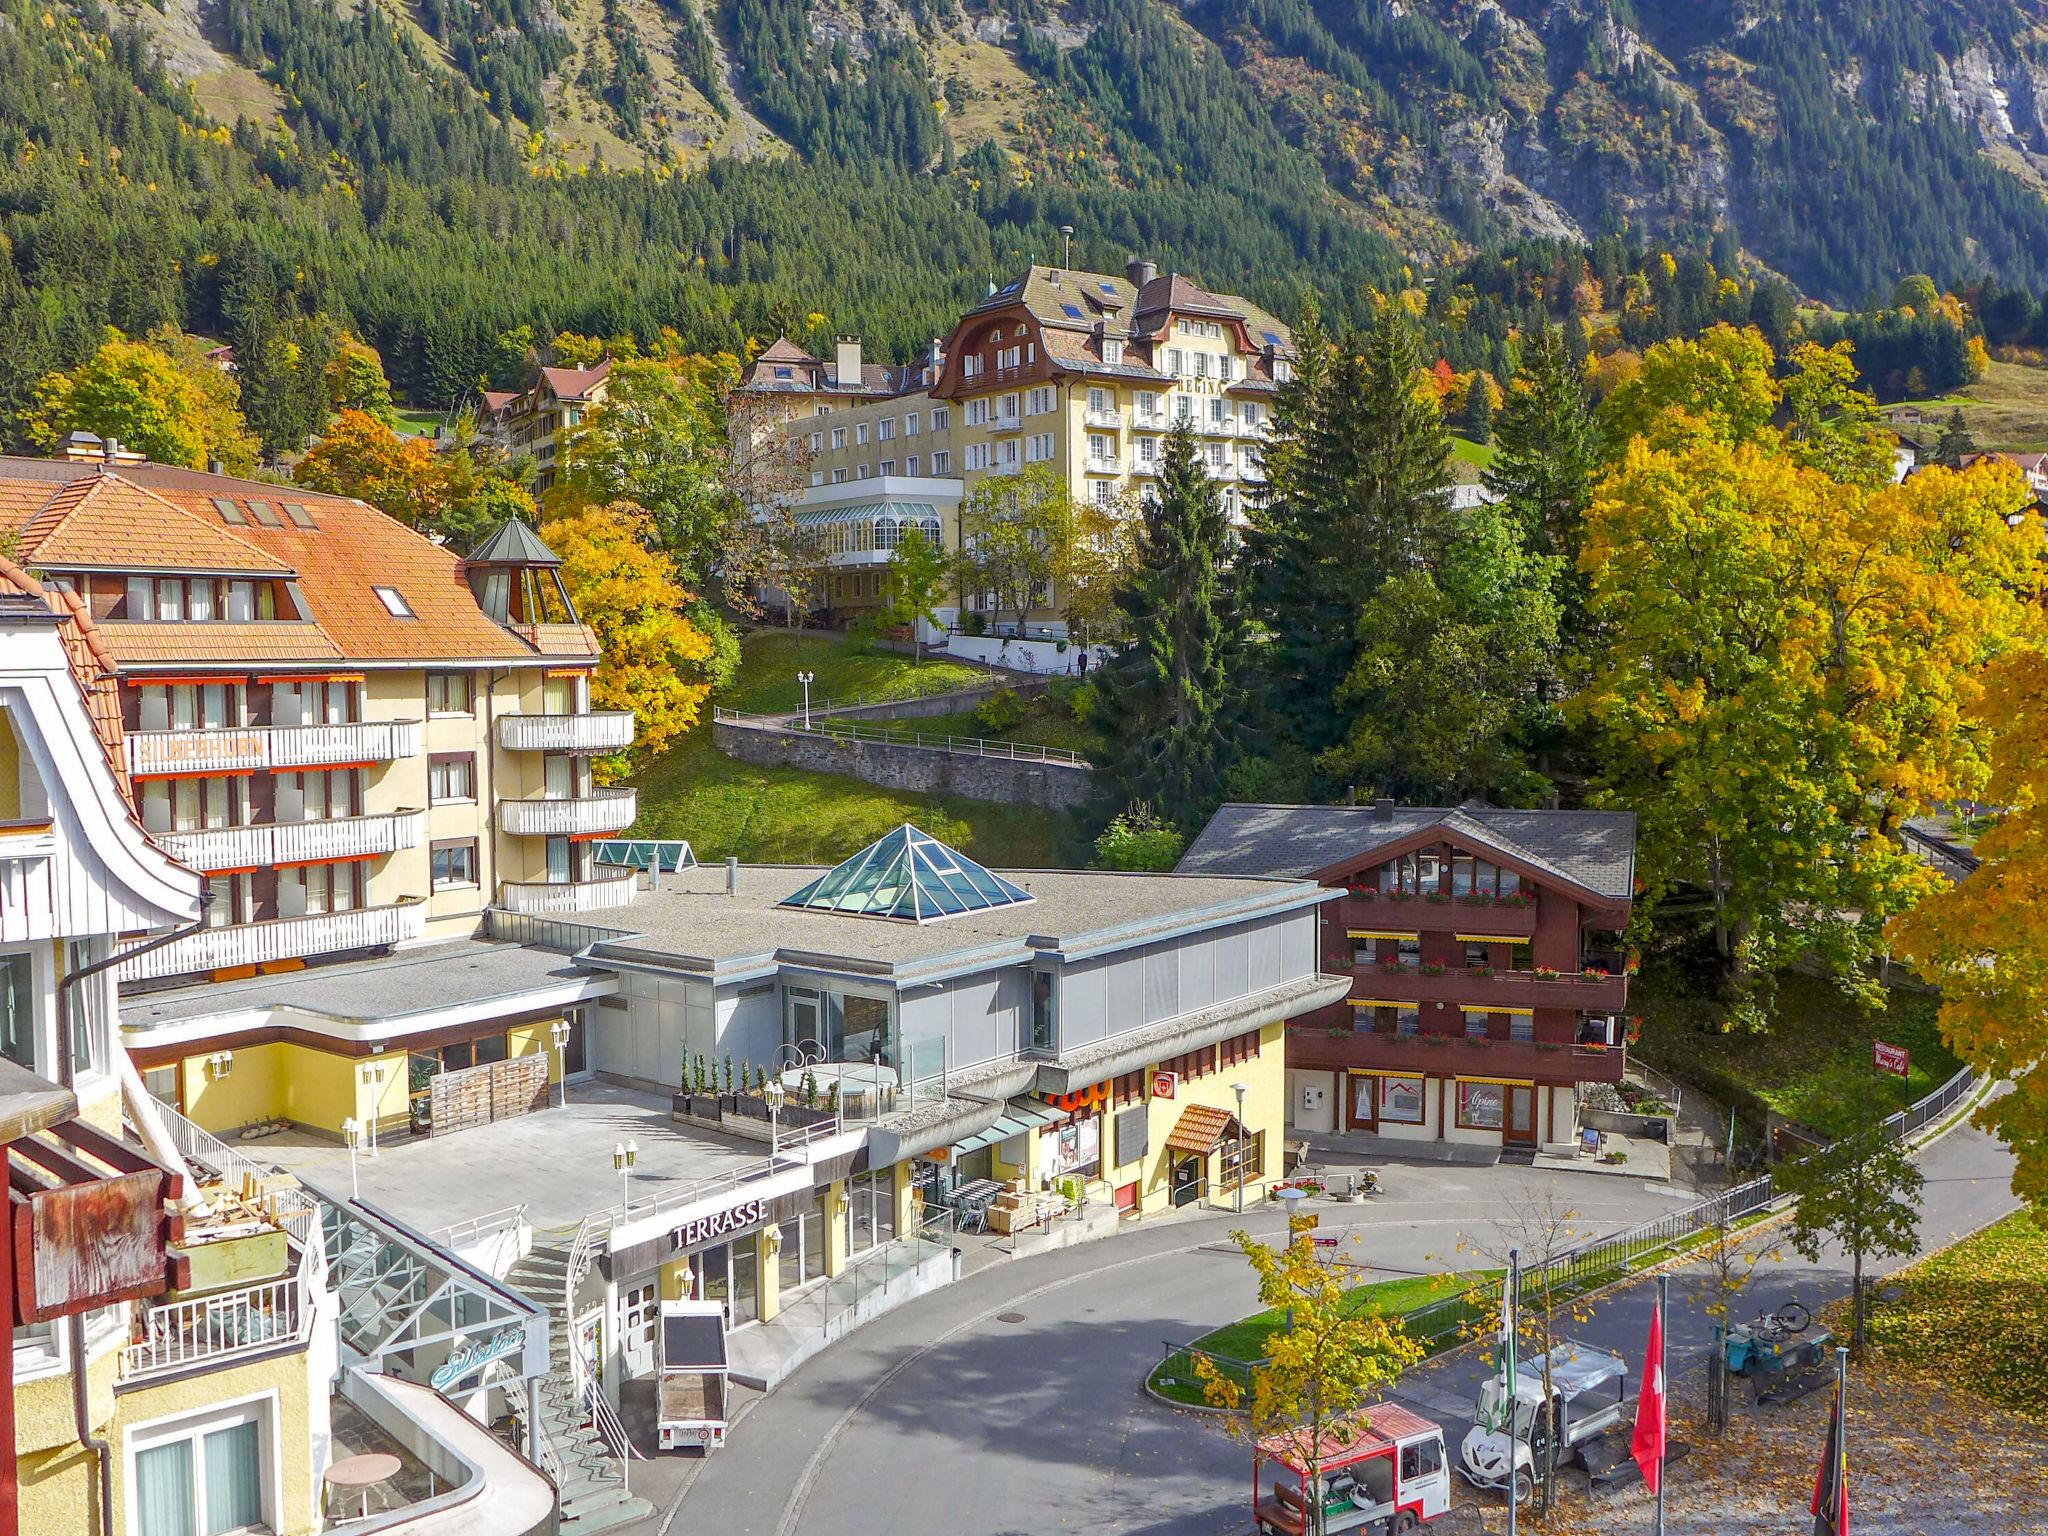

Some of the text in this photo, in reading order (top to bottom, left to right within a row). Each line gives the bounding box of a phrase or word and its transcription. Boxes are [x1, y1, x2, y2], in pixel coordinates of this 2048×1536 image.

[1177, 378, 1223, 395] REGINA
[140, 738, 263, 762] SILBERHORN
[1875, 1042, 1905, 1058] RESTAURANT
[1460, 1089, 1501, 1109] Alpine
[673, 1198, 769, 1249] TERRASSE
